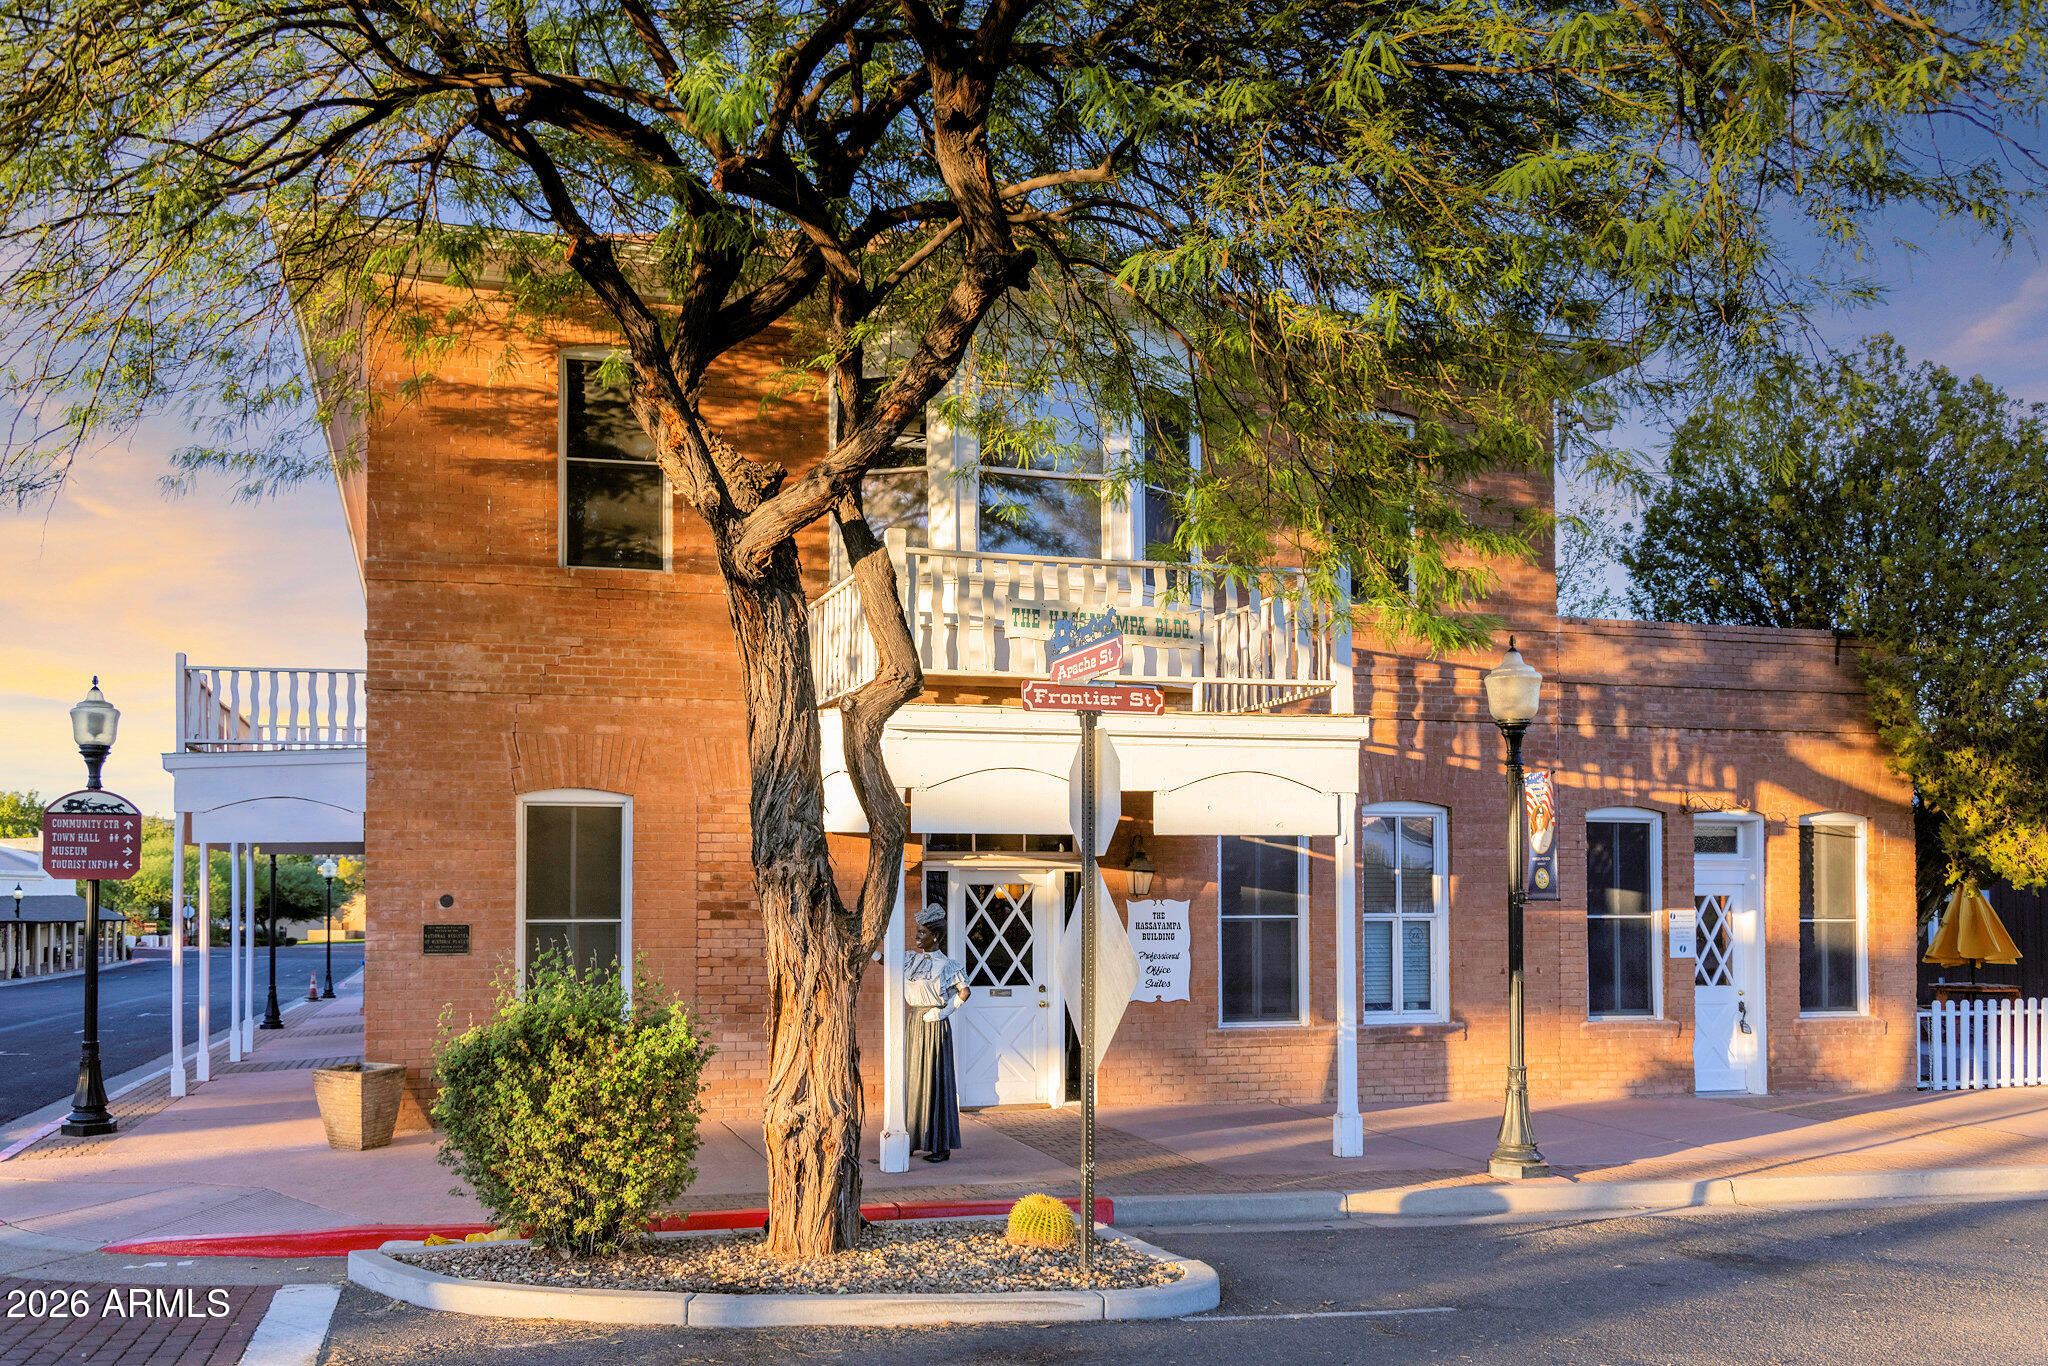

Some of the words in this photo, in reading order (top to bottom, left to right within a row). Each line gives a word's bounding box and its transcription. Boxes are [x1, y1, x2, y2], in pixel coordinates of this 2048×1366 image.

[1011, 607, 1041, 629] THE
[1155, 618, 1194, 640] BLDG.
[1057, 656, 1097, 681] Apache
[1099, 648, 1114, 666] St
[1033, 688, 1123, 707] Frontier
[1129, 691, 1155, 708] St
[51, 818, 101, 829] COMMUNITY
[103, 819, 120, 829] CTR
[51, 832, 75, 842] TOWN
[77, 833, 100, 843] HALL
[51, 846, 88, 856] MUSEUM
[51, 859, 86, 869] TOURIST
[88, 859, 108, 870] INFO
[1152, 911, 1166, 920] THE
[1135, 921, 1182, 930] HASSAYAMPA
[1142, 932, 1176, 941] BUILDING
[1138, 951, 1181, 962] Professional
[1145, 965, 1172, 977] Office
[1144, 978, 1171, 989] Suites
